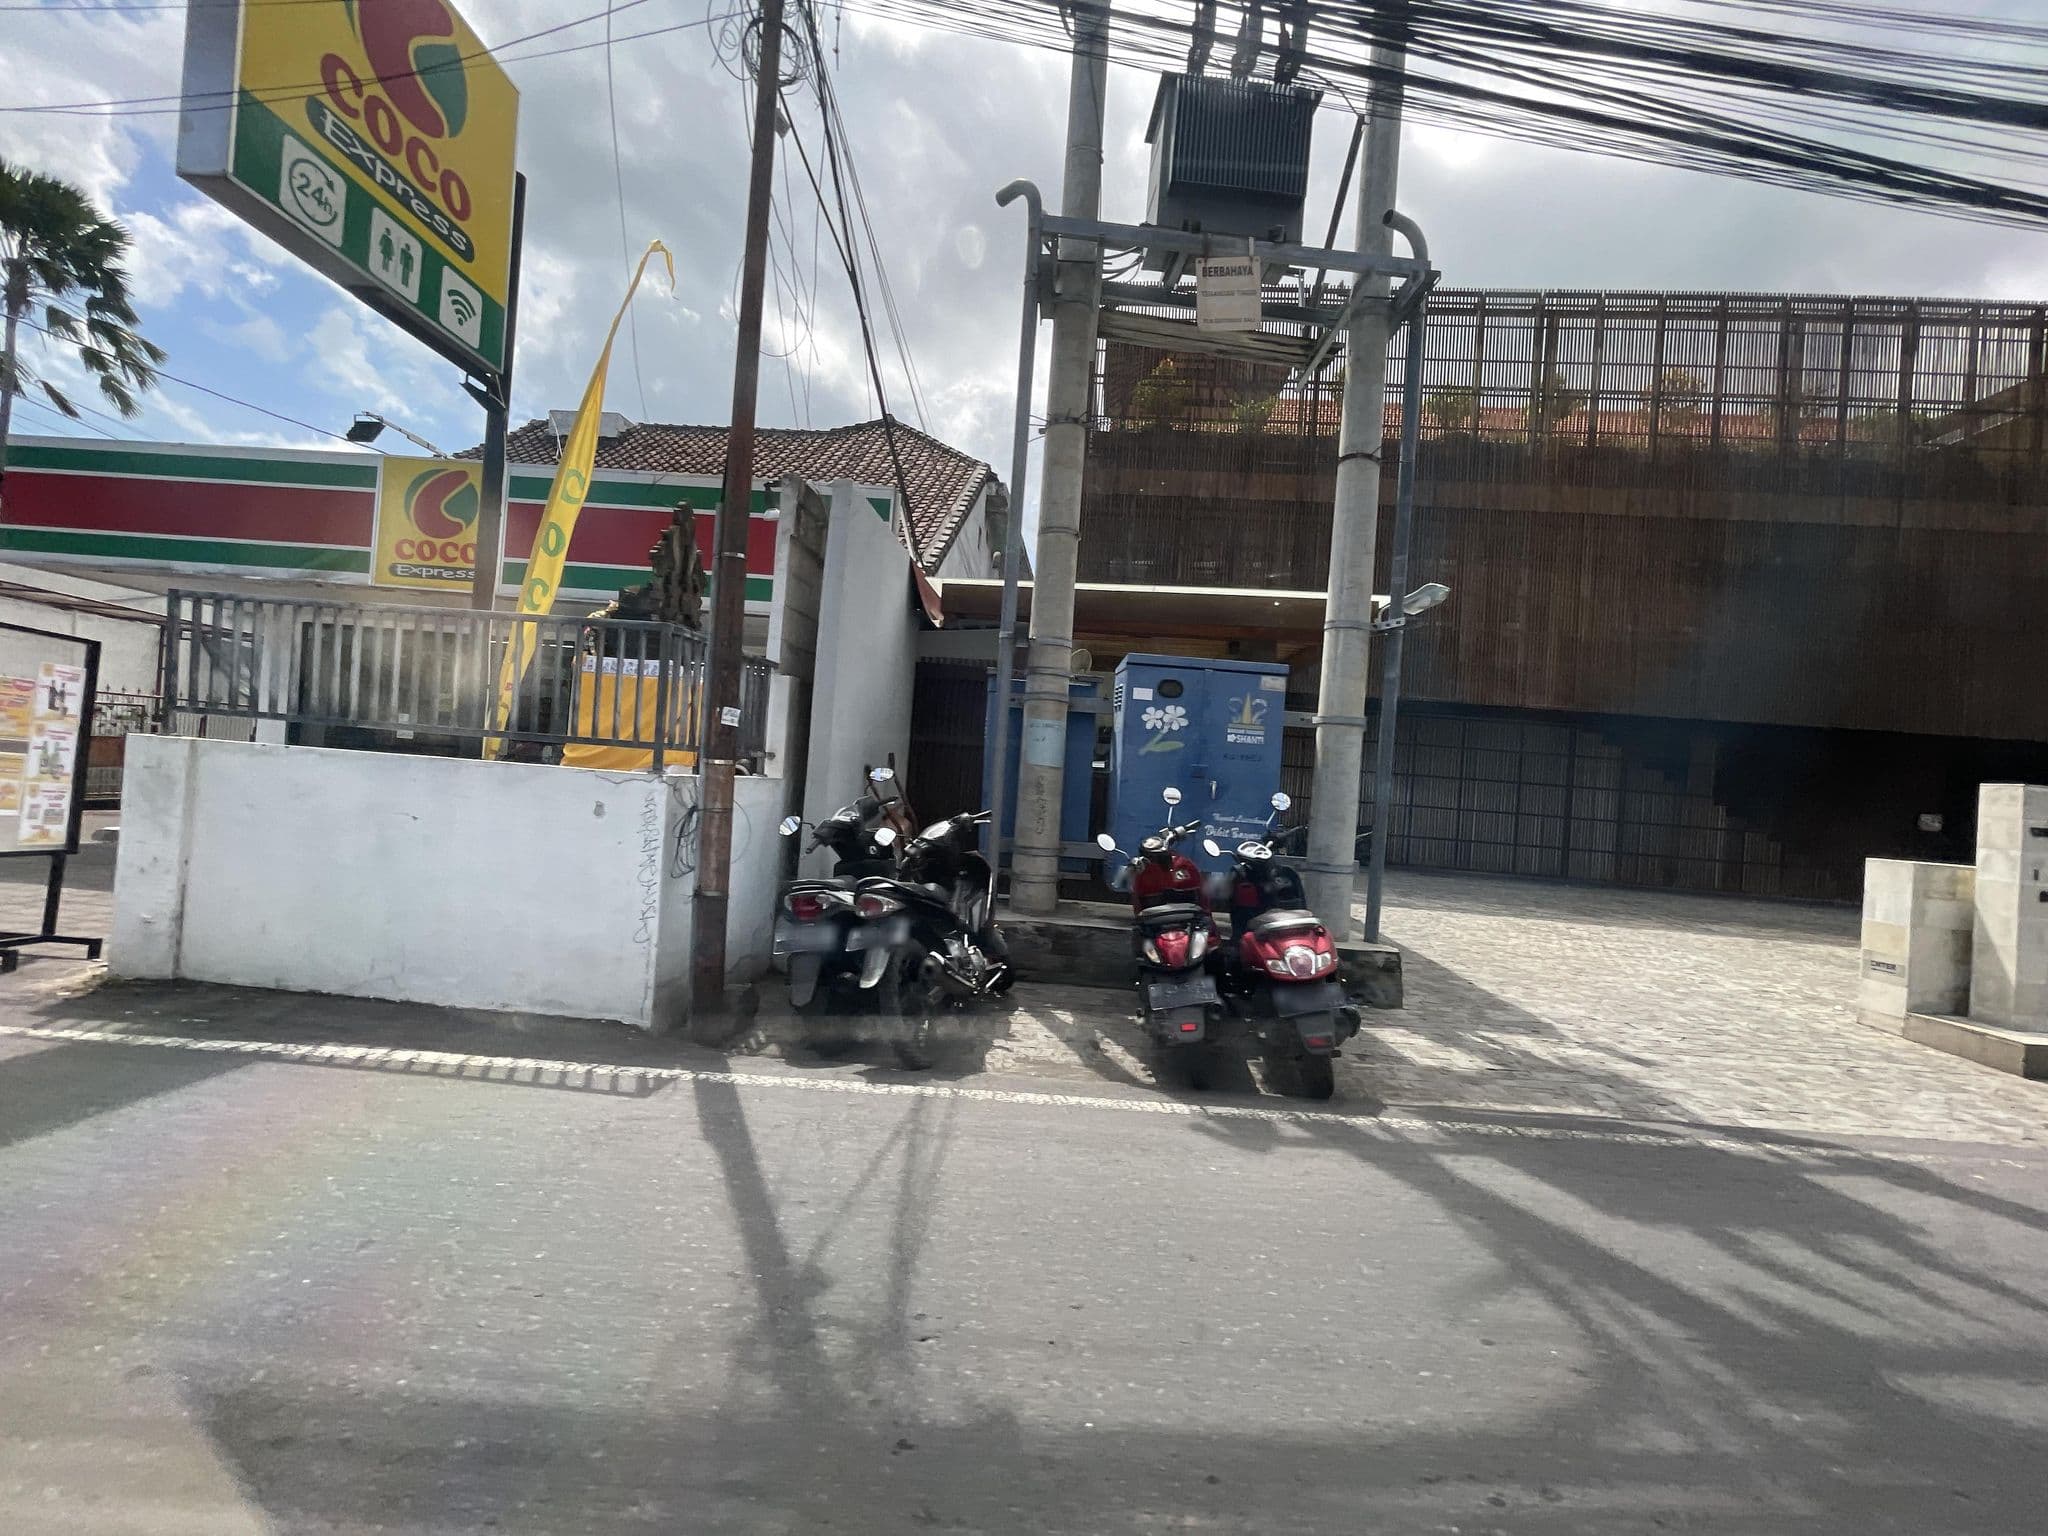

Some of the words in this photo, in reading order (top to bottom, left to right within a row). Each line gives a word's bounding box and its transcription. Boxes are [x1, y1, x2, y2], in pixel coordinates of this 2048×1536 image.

[320, 53, 472, 222] COCO
[320, 108, 468, 252] Express
[1202, 265, 1254, 278] BERBAHAYA
